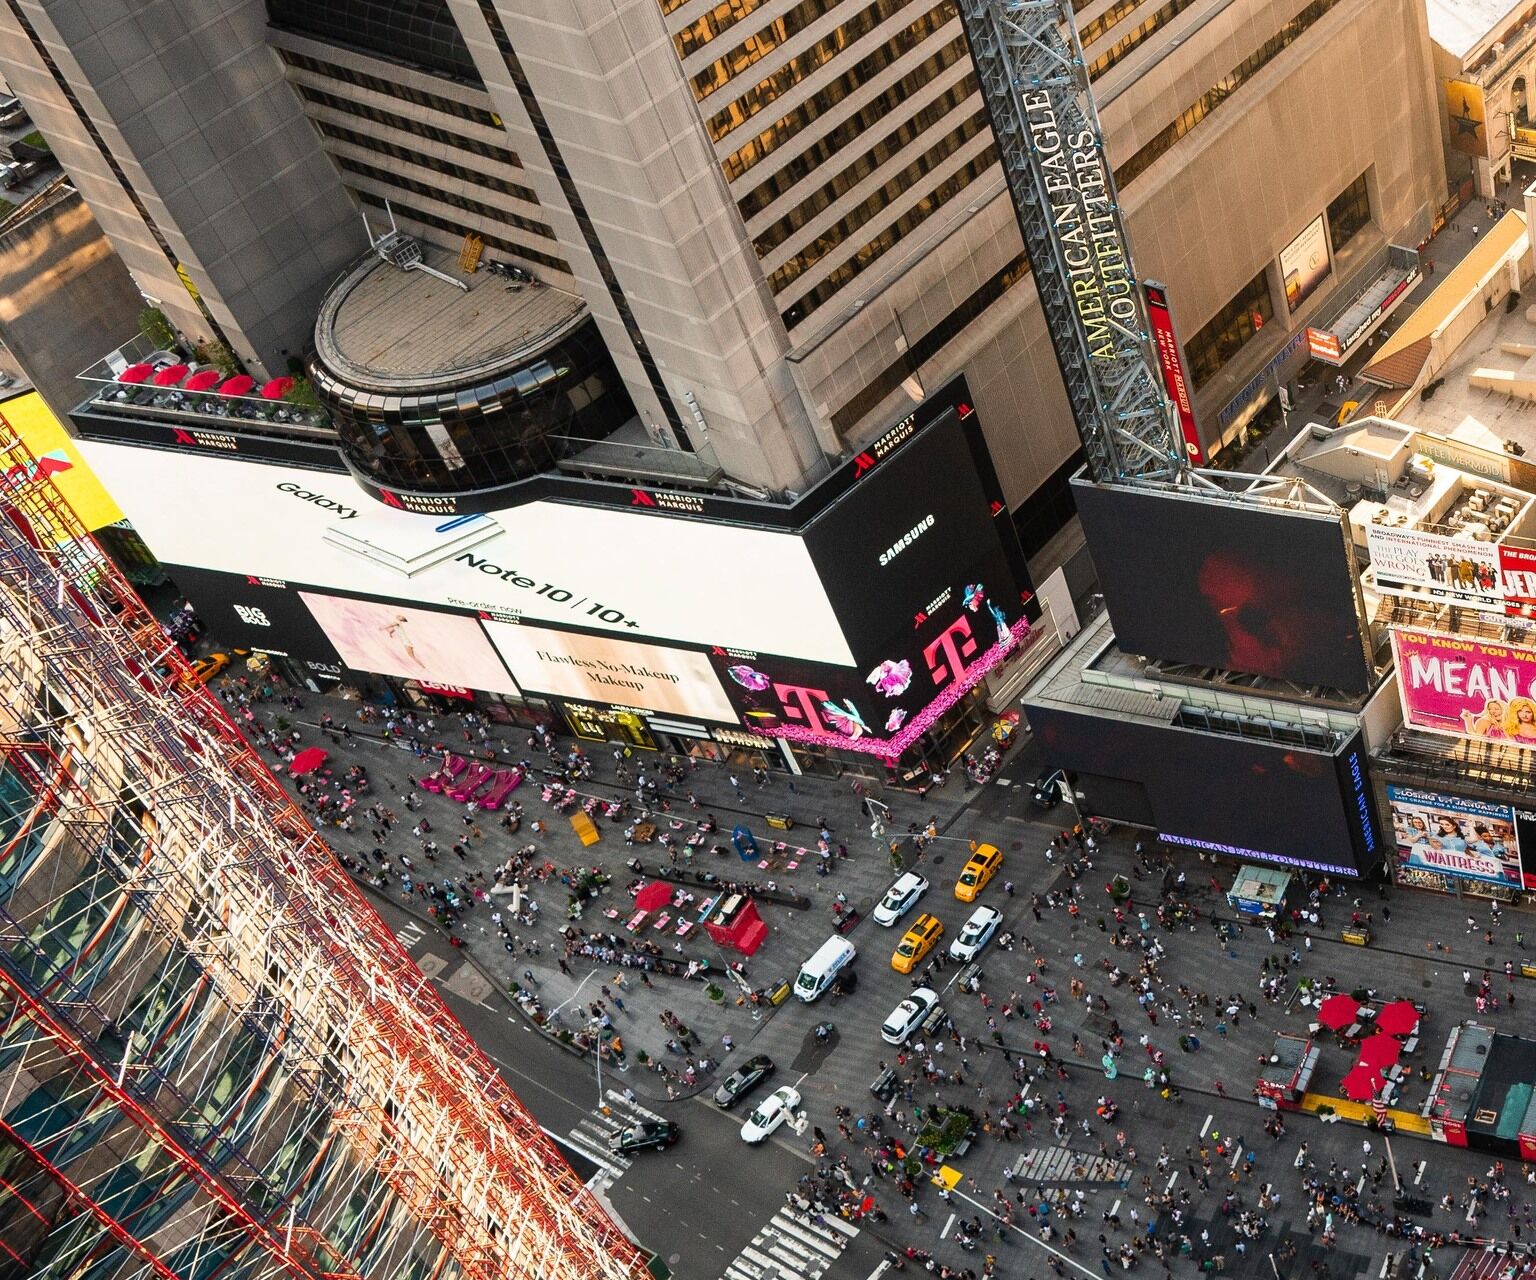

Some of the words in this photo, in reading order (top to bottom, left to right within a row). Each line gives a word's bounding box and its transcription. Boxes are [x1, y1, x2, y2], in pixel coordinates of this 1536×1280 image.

[1022, 89, 1072, 195] EAGLE
[1067, 128, 1137, 321] OUTFITTERS
[1068, 203, 1117, 361] AMERICAN
[1165, 330, 1180, 375] MARRIOTT
[873, 413, 916, 450] MARRIOTT
[877, 424, 914, 458] MARQUIS
[276, 482, 360, 520] Galaxy
[401, 494, 457, 506] MARRIOTT
[405, 502, 456, 513] MARQUIS
[655, 492, 704, 505] MARRIOTT
[658, 500, 703, 513] MARQUIS
[879, 514, 936, 567] SAMSUNG
[1393, 547, 1419, 557] PLAY
[1503, 550, 1518, 558] THE
[1374, 558, 1426, 577] WRONG
[455, 552, 537, 590] Note
[535, 583, 575, 604] 10
[586, 602, 640, 629] 10+
[233, 604, 266, 621] BIG
[1400, 632, 1427, 645] YOU
[1432, 638, 1474, 652] KNOW
[1480, 646, 1508, 658] YOU
[536, 650, 597, 669] Flawless
[598, 660, 680, 683] No-Makeup
[587, 672, 644, 692] Makeup
[1409, 652, 1518, 702] MEAN
[1349, 752, 1363, 791] EAGLE
[1360, 792, 1375, 852] AMERICAN
[1423, 849, 1495, 874] WAITRESS
